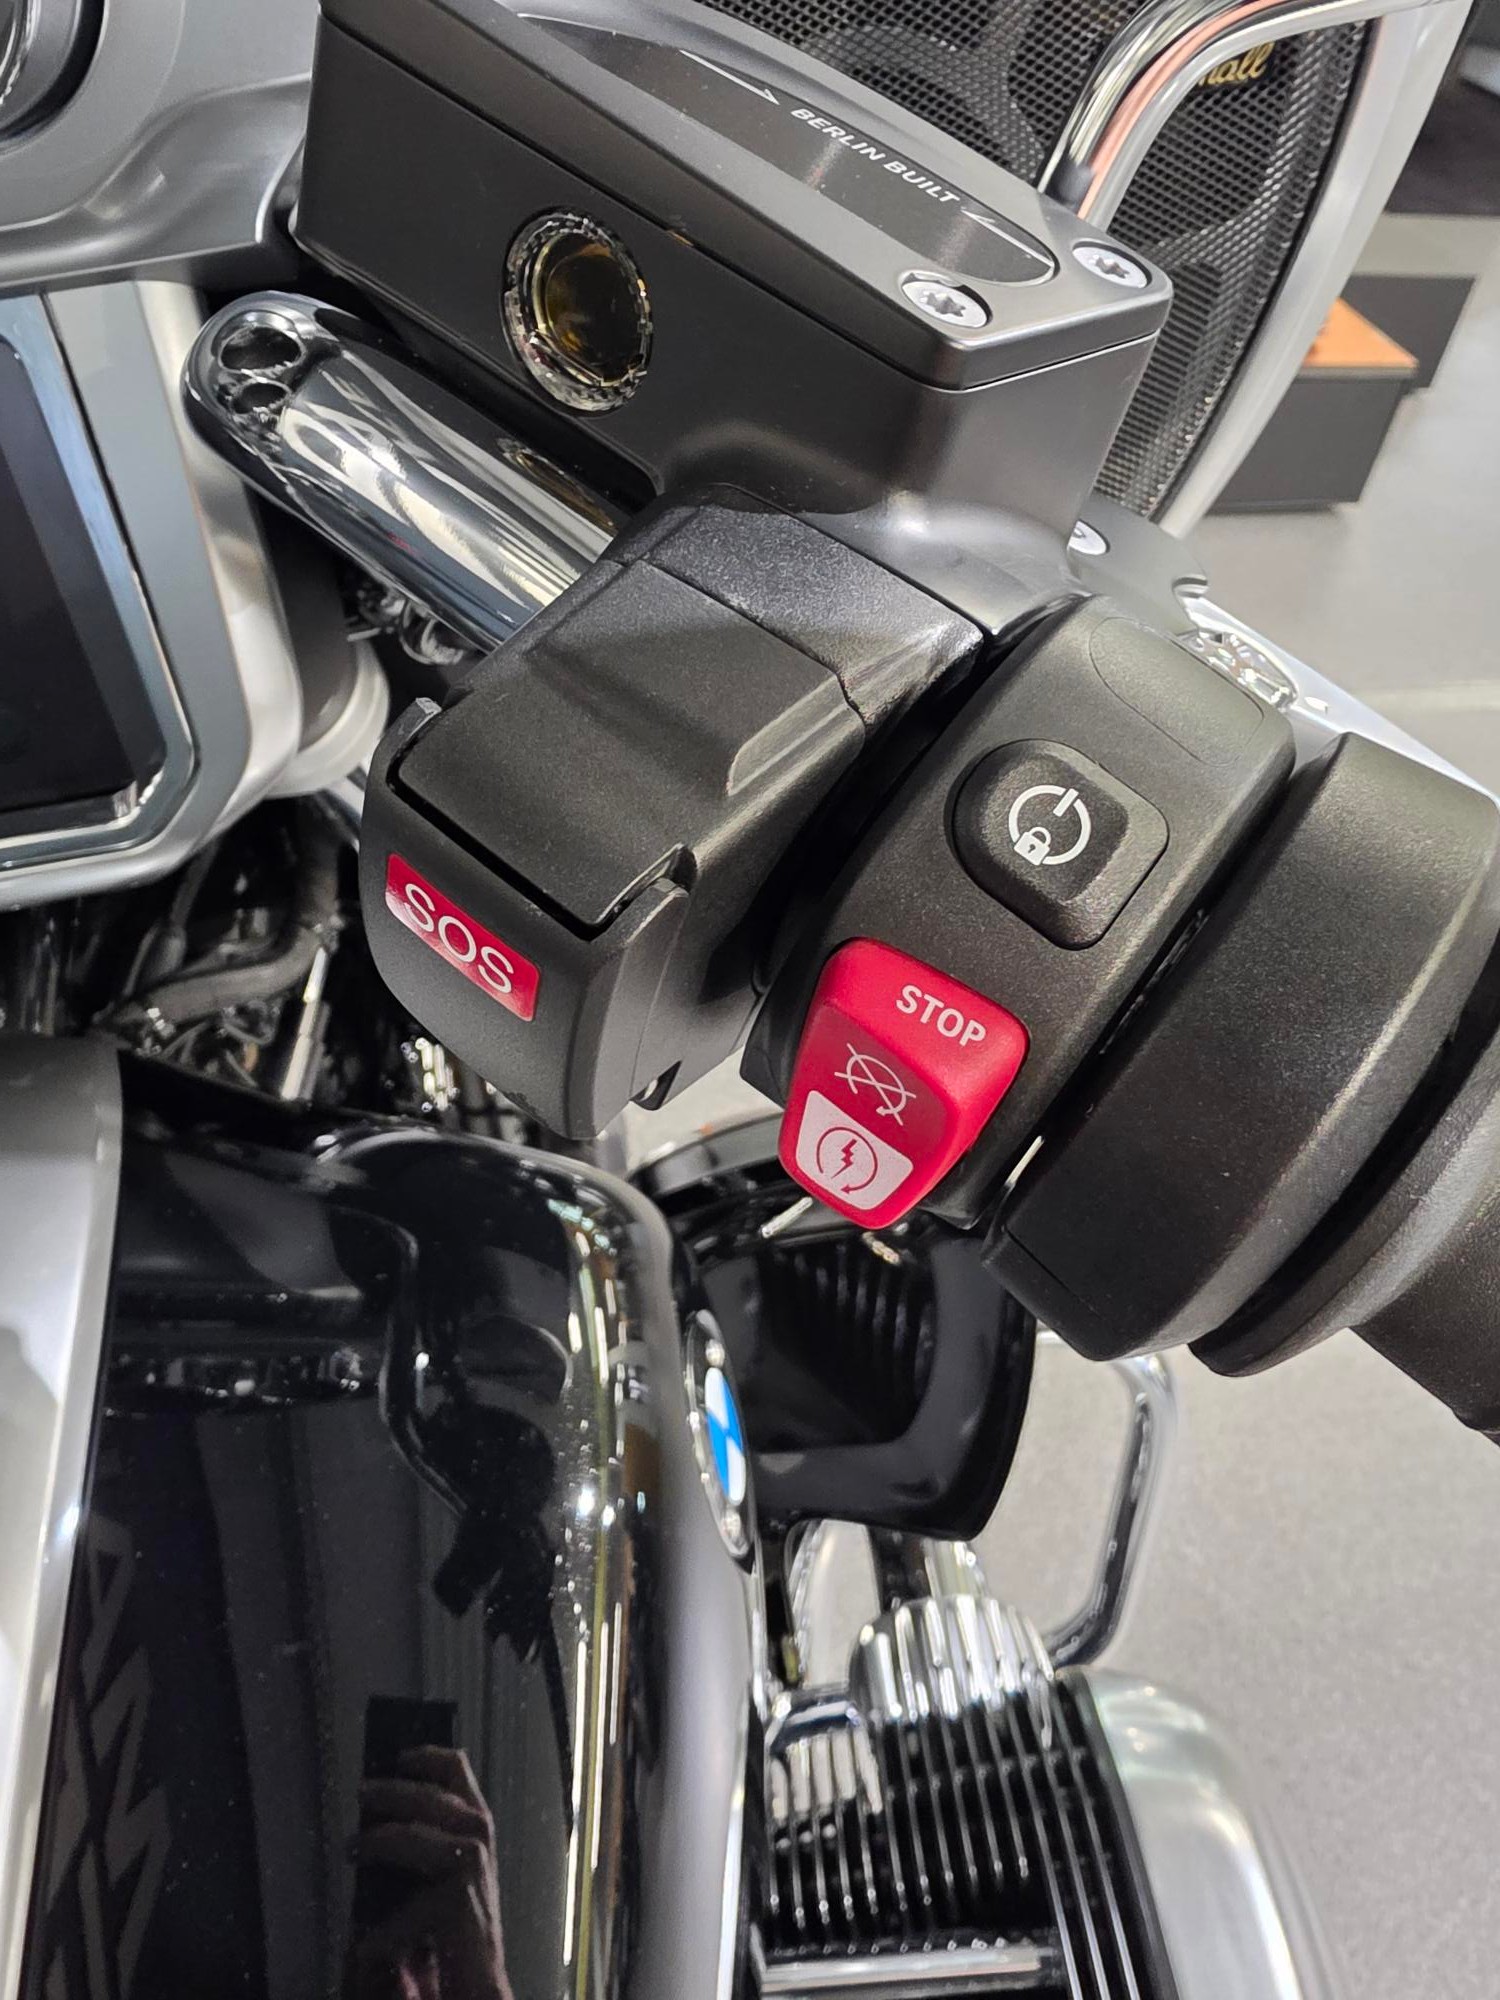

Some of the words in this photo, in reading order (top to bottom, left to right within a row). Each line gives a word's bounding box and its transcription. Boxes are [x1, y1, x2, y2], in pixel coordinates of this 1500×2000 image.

[790, 108, 886, 161] BERLIN
[883, 160, 961, 202] BUILT
[404, 883, 514, 994] SOS
[895, 984, 987, 1047] STOP
